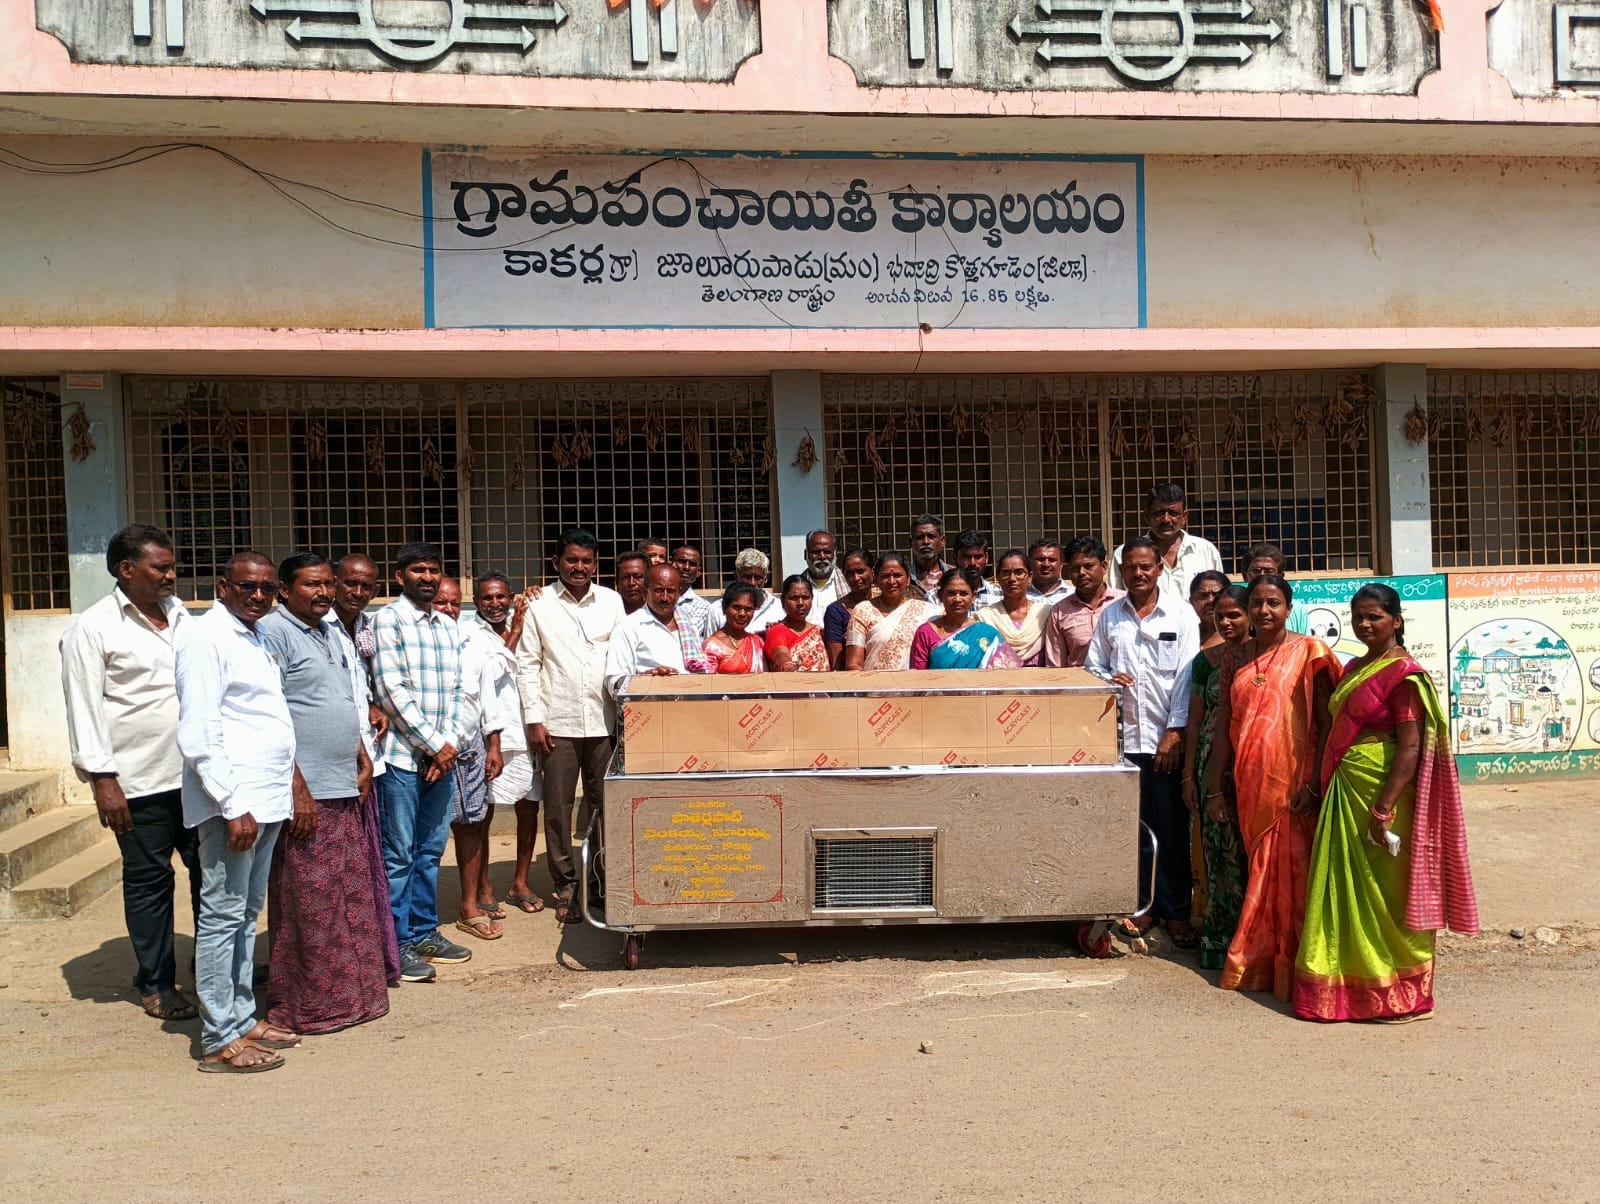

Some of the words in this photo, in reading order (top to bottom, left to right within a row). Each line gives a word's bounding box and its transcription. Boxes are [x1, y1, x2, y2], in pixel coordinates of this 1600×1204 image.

[888, 180, 1125, 248] కార్యాలయం
[701, 284, 783, 303] తెలంగాణ
[787, 283, 836, 313] రాష్ట్రం
[961, 288, 1008, 303] 16.85
[738, 702, 763, 729] CG
[745, 709, 774, 740] ACRYCAST
[867, 701, 892, 727] CG
[874, 706, 903, 738] ACRYCAST
[996, 699, 1021, 725] CG
[1003, 704, 1032, 736] ACRYCAST
